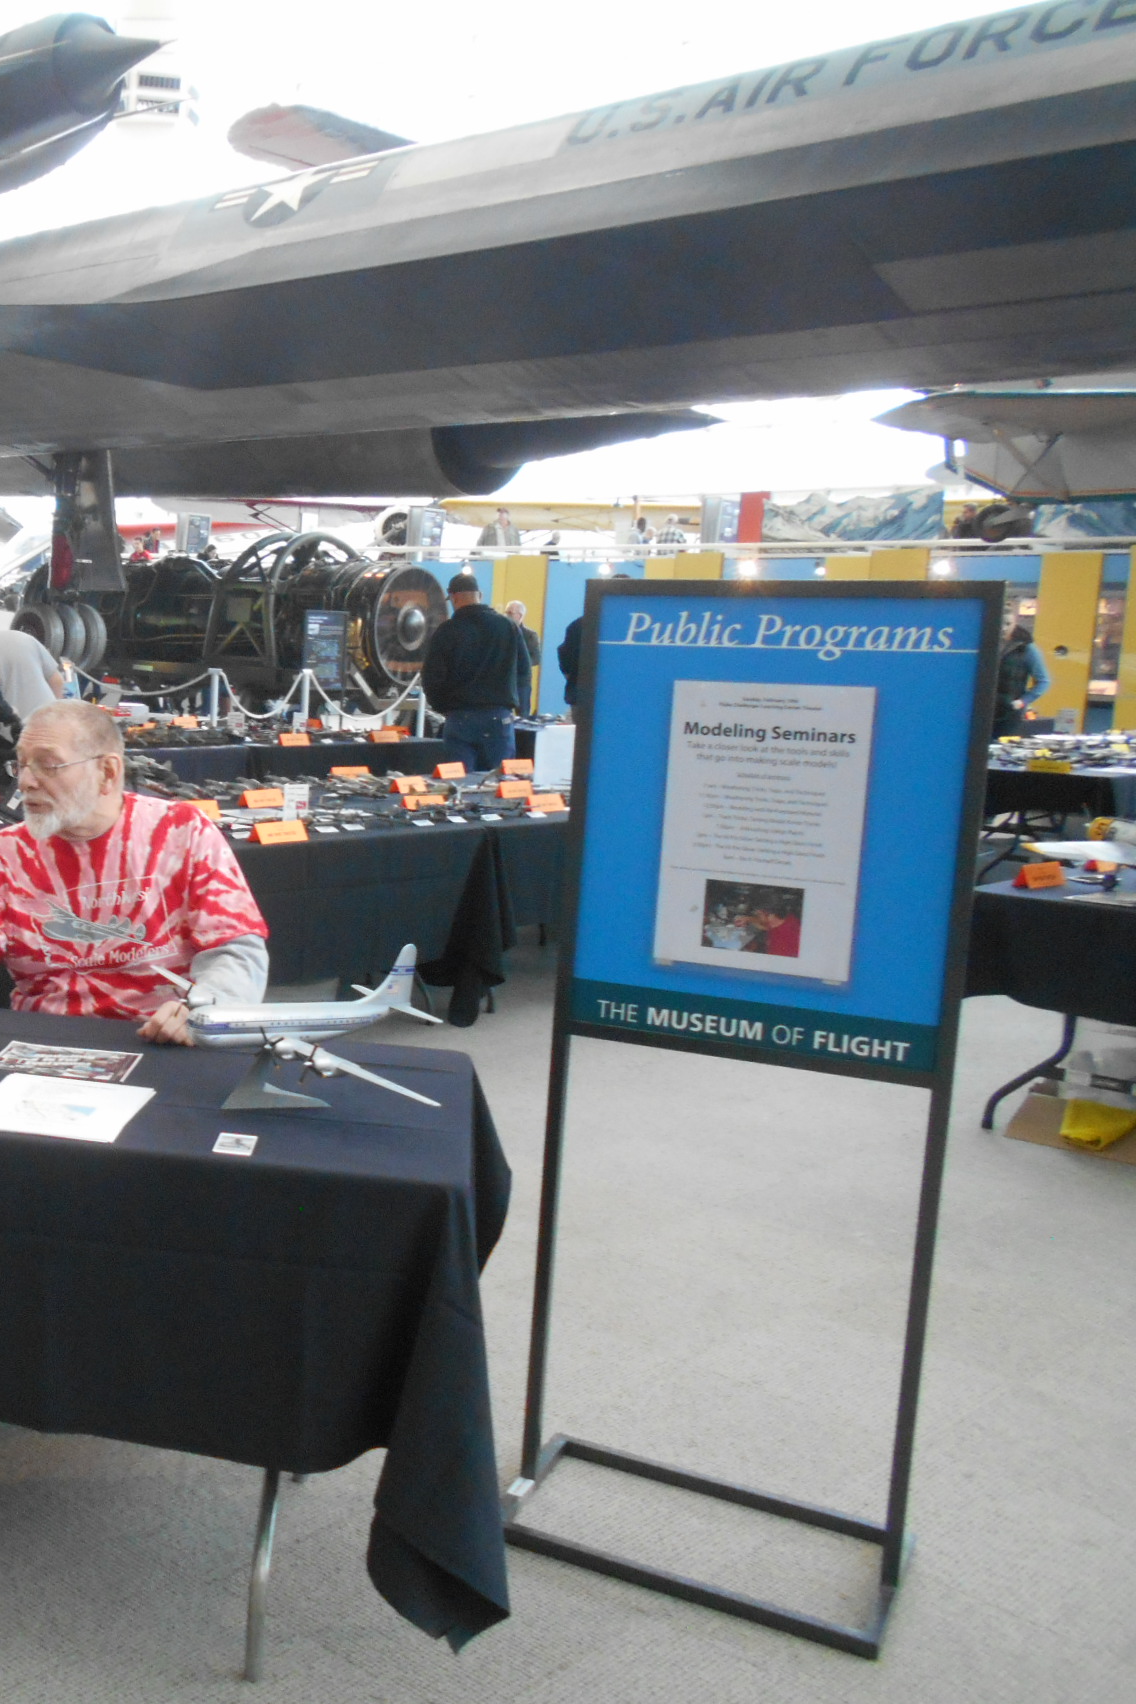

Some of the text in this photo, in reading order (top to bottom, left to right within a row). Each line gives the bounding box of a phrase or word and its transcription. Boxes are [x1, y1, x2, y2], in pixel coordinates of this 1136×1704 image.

[623, 611, 954, 661] Public Programs
[684, 721, 857, 744] Modeling Seminars
[687, 741, 706, 750] Take
[714, 742, 738, 751] closer
[741, 743, 758, 752] look
[771, 745, 785, 754] the
[786, 746, 808, 756] tools
[810, 747, 828, 757] and
[829, 748, 851, 758] skills
[696, 752, 714, 761] that
[715, 754, 727, 763] go
[729, 754, 745, 763] into
[746, 755, 778, 766] making
[779, 757, 800, 767] scale
[70, 944, 170, 968] Scale Modelers
[597, 999, 911, 1062] THE MUSEUM OF FLIGHT
